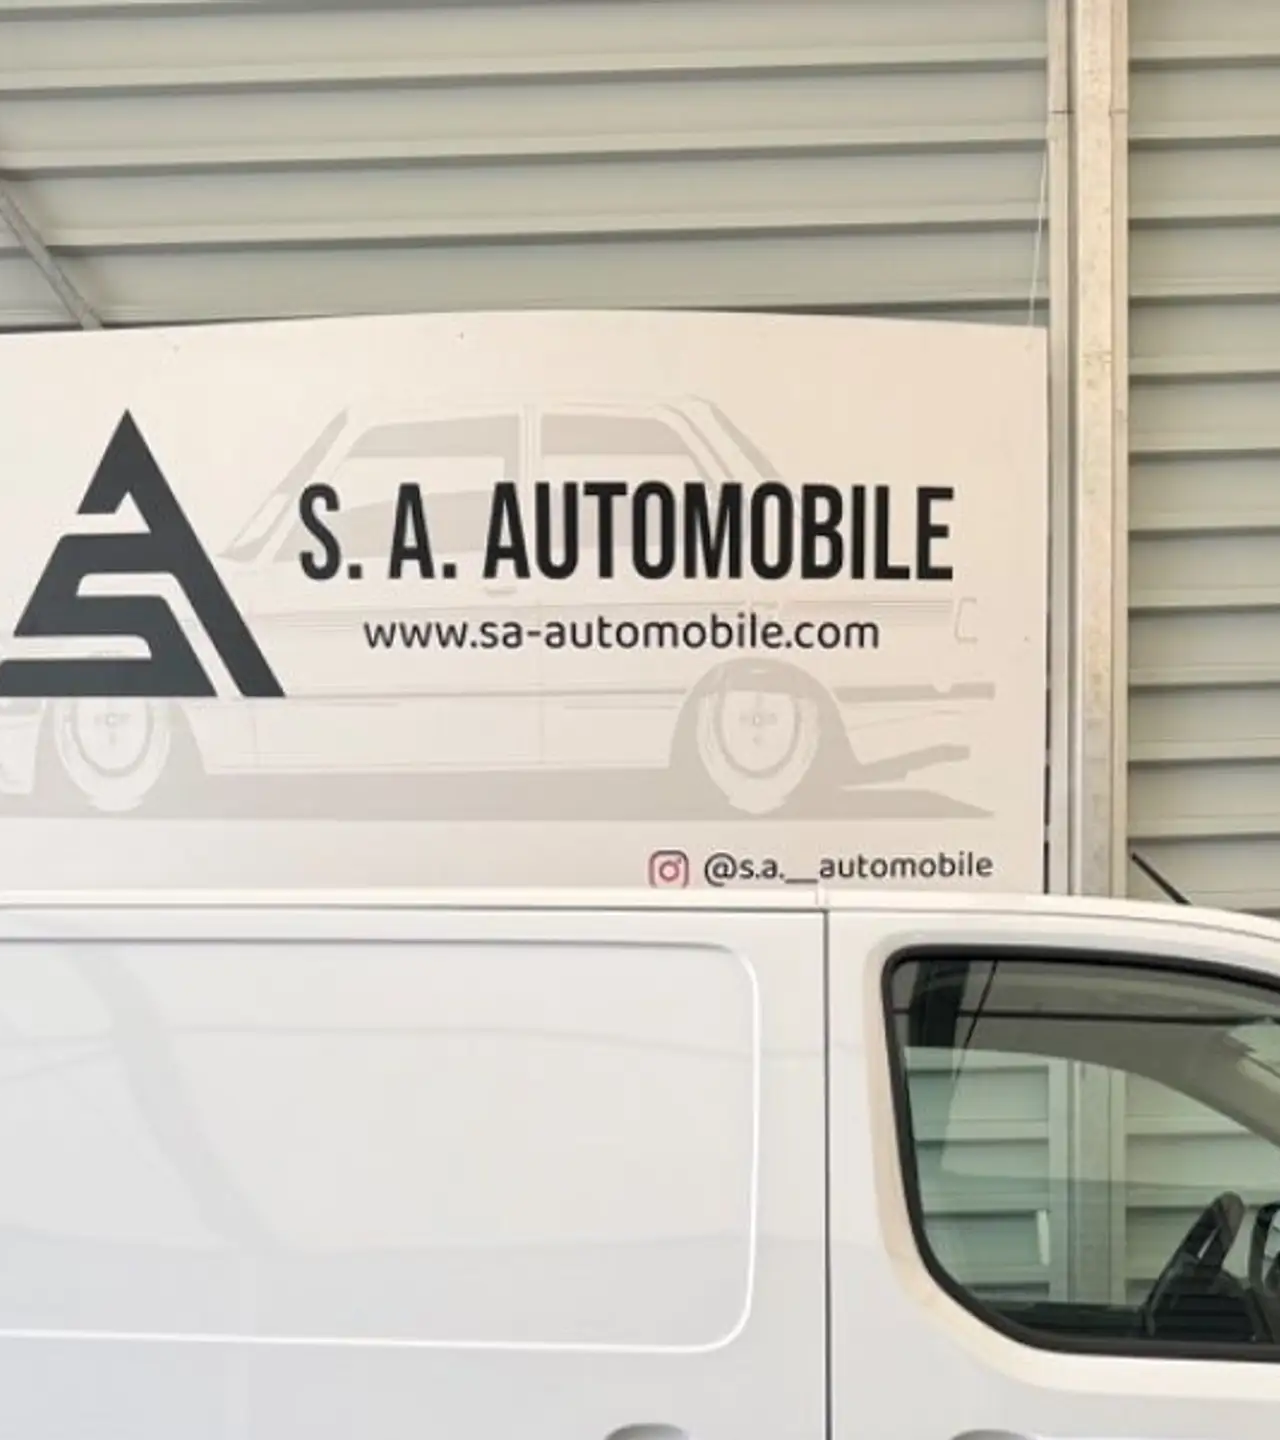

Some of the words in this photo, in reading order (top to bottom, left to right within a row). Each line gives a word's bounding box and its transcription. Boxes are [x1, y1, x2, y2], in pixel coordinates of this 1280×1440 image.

[297, 482, 364, 581] S.
[388, 482, 458, 581] A.
[482, 480, 956, 581] AUTOMOBILE
[362, 611, 881, 651] www.sa-automobile.com
